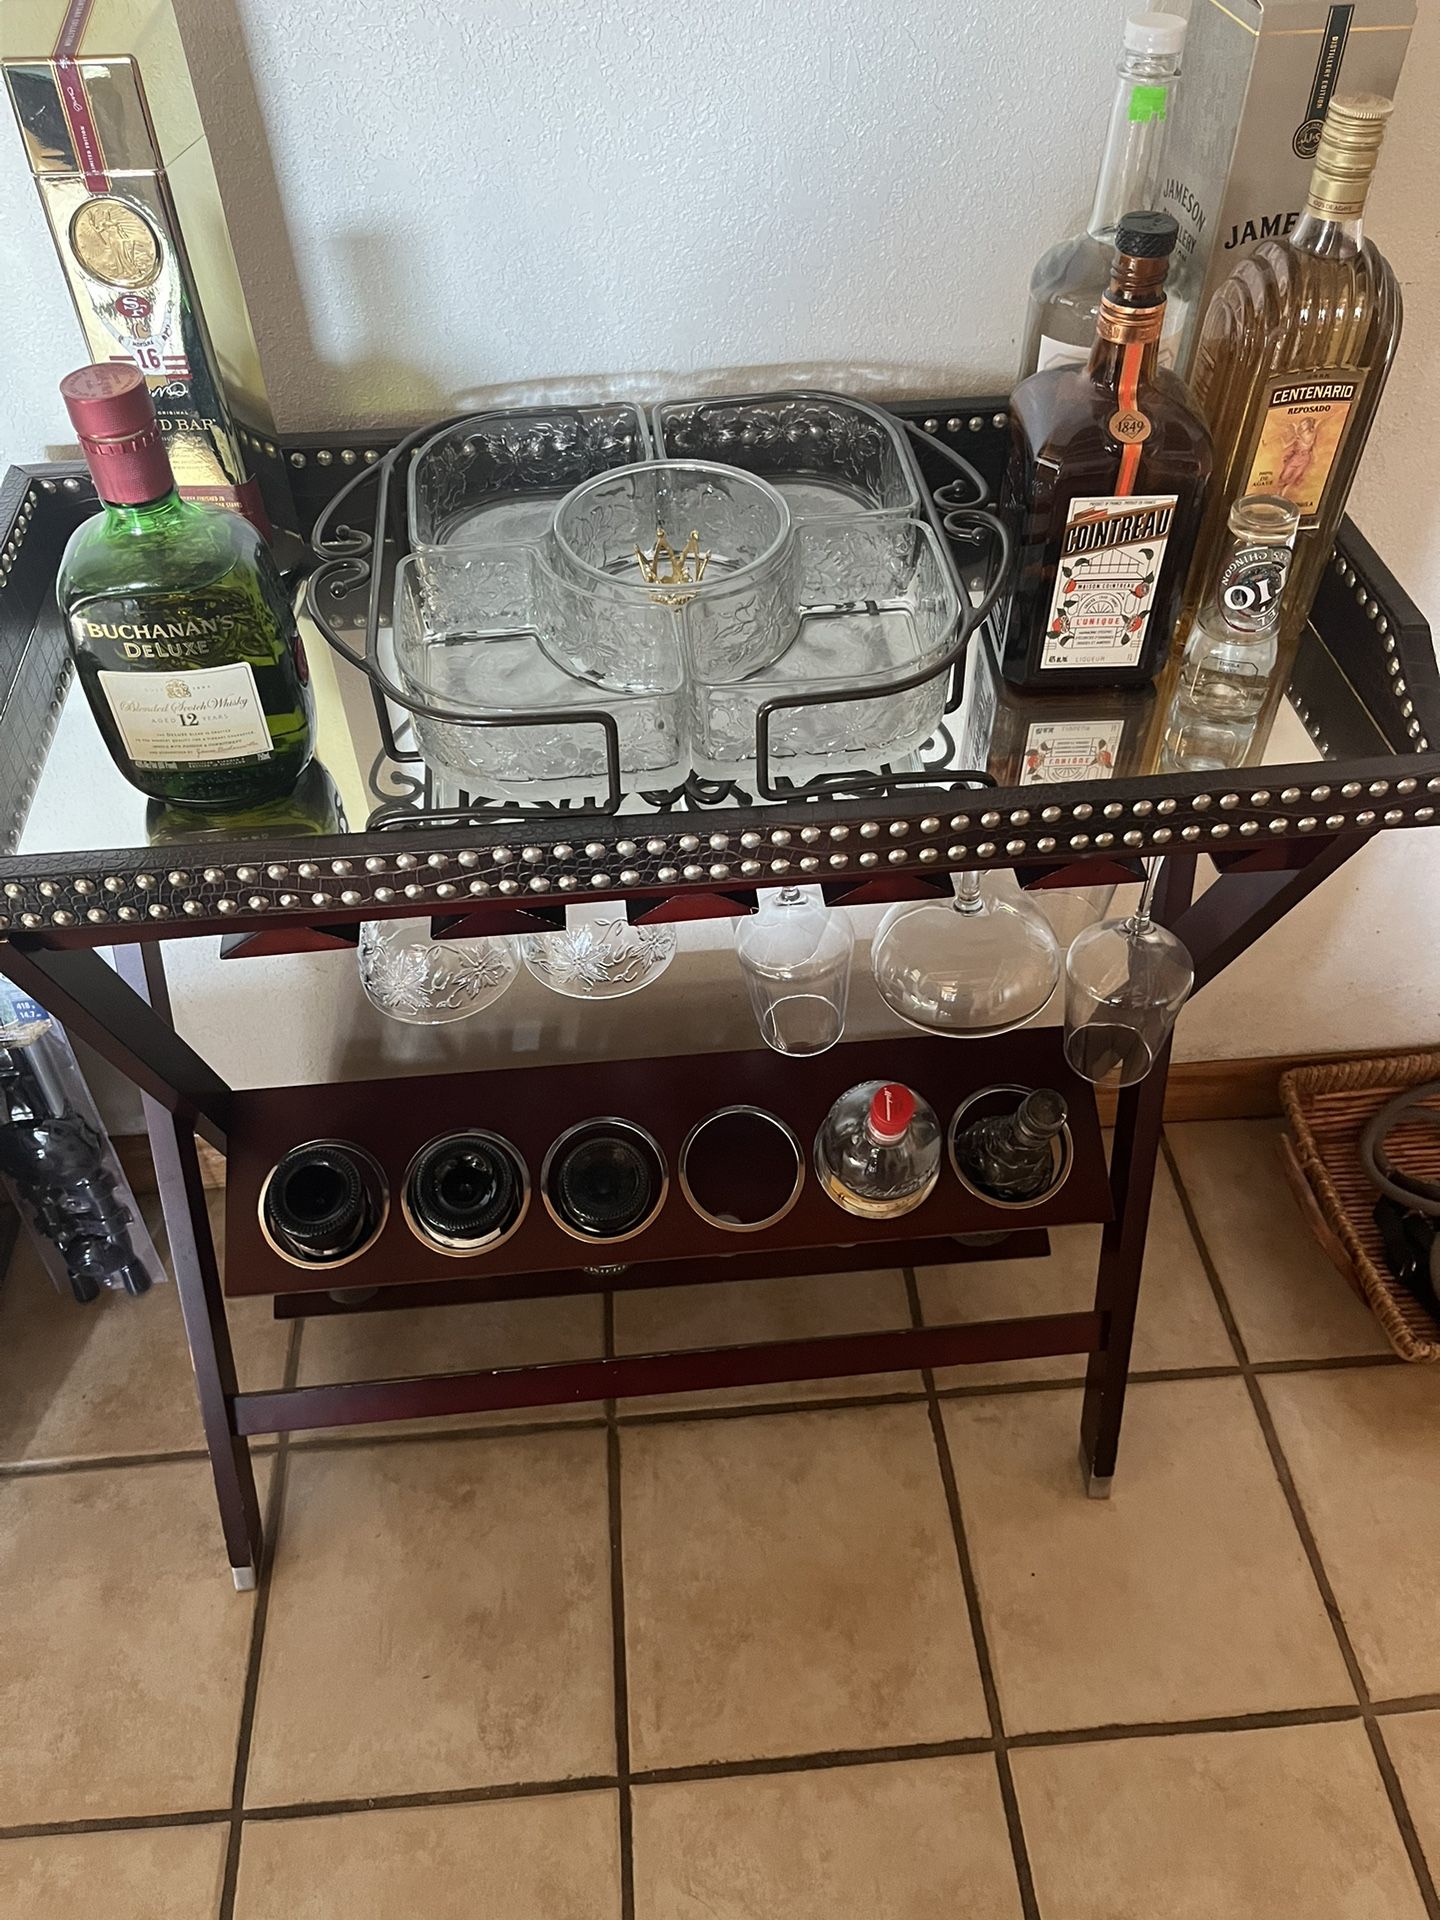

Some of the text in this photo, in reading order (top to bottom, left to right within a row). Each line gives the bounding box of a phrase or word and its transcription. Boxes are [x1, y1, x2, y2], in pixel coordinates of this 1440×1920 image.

[1323, 35, 1339, 78] DISTILLERY
[1316, 80, 1329, 109] EDITION
[1163, 178, 1206, 232] JAMESON
[1224, 212, 1300, 249] JAME
[121, 296, 148, 317] SF
[136, 348, 161, 369] 16
[1272, 385, 1354, 404] CENTENARIO
[1287, 404, 1331, 415] REPOSADO
[1117, 421, 1145, 434] 1849
[1065, 507, 1174, 554] COINTREAU
[86, 614, 235, 640] BUCHANAN'S
[1076, 617, 1120, 626] L'UNIQUE
[1257, 608, 1277, 626] EL
[119, 695, 249, 713] Blended Scotch Whisky
[177, 712, 200, 727] 12
[202, 714, 230, 722] YEARS
